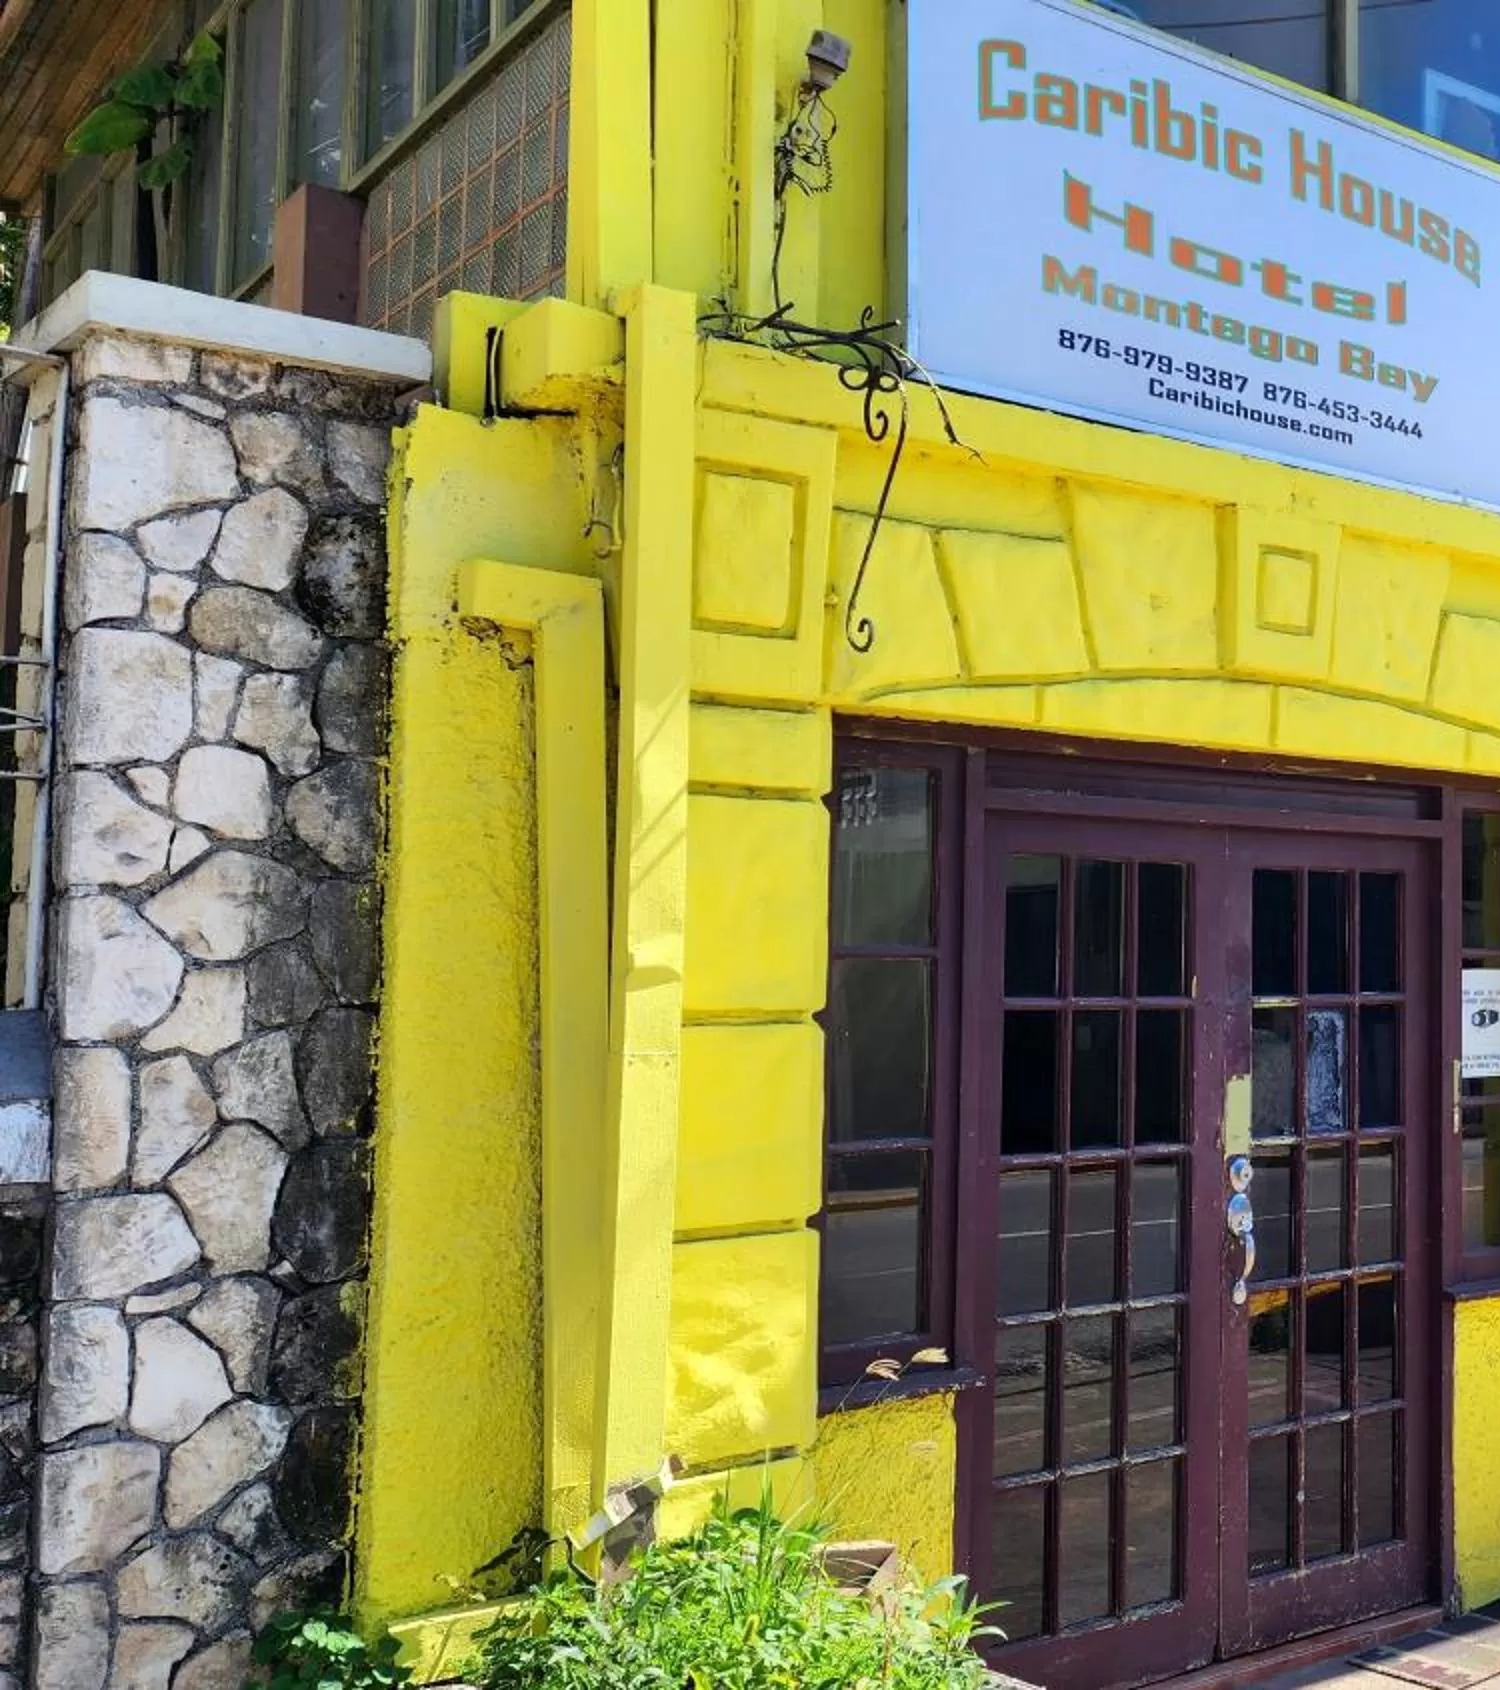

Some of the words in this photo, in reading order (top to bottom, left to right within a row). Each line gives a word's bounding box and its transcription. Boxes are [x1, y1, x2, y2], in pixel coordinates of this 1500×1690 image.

[977, 38, 1263, 185] Caribic
[1289, 127, 1481, 288] House
[1062, 168, 1408, 325] Hotel
[1041, 253, 1319, 366] Montego
[1338, 338, 1439, 404] Bay
[1057, 328, 1250, 393] 876-979-9387
[1262, 381, 1424, 440] 876-453-3444
[1147, 376, 1354, 446] Caribichouse.com
